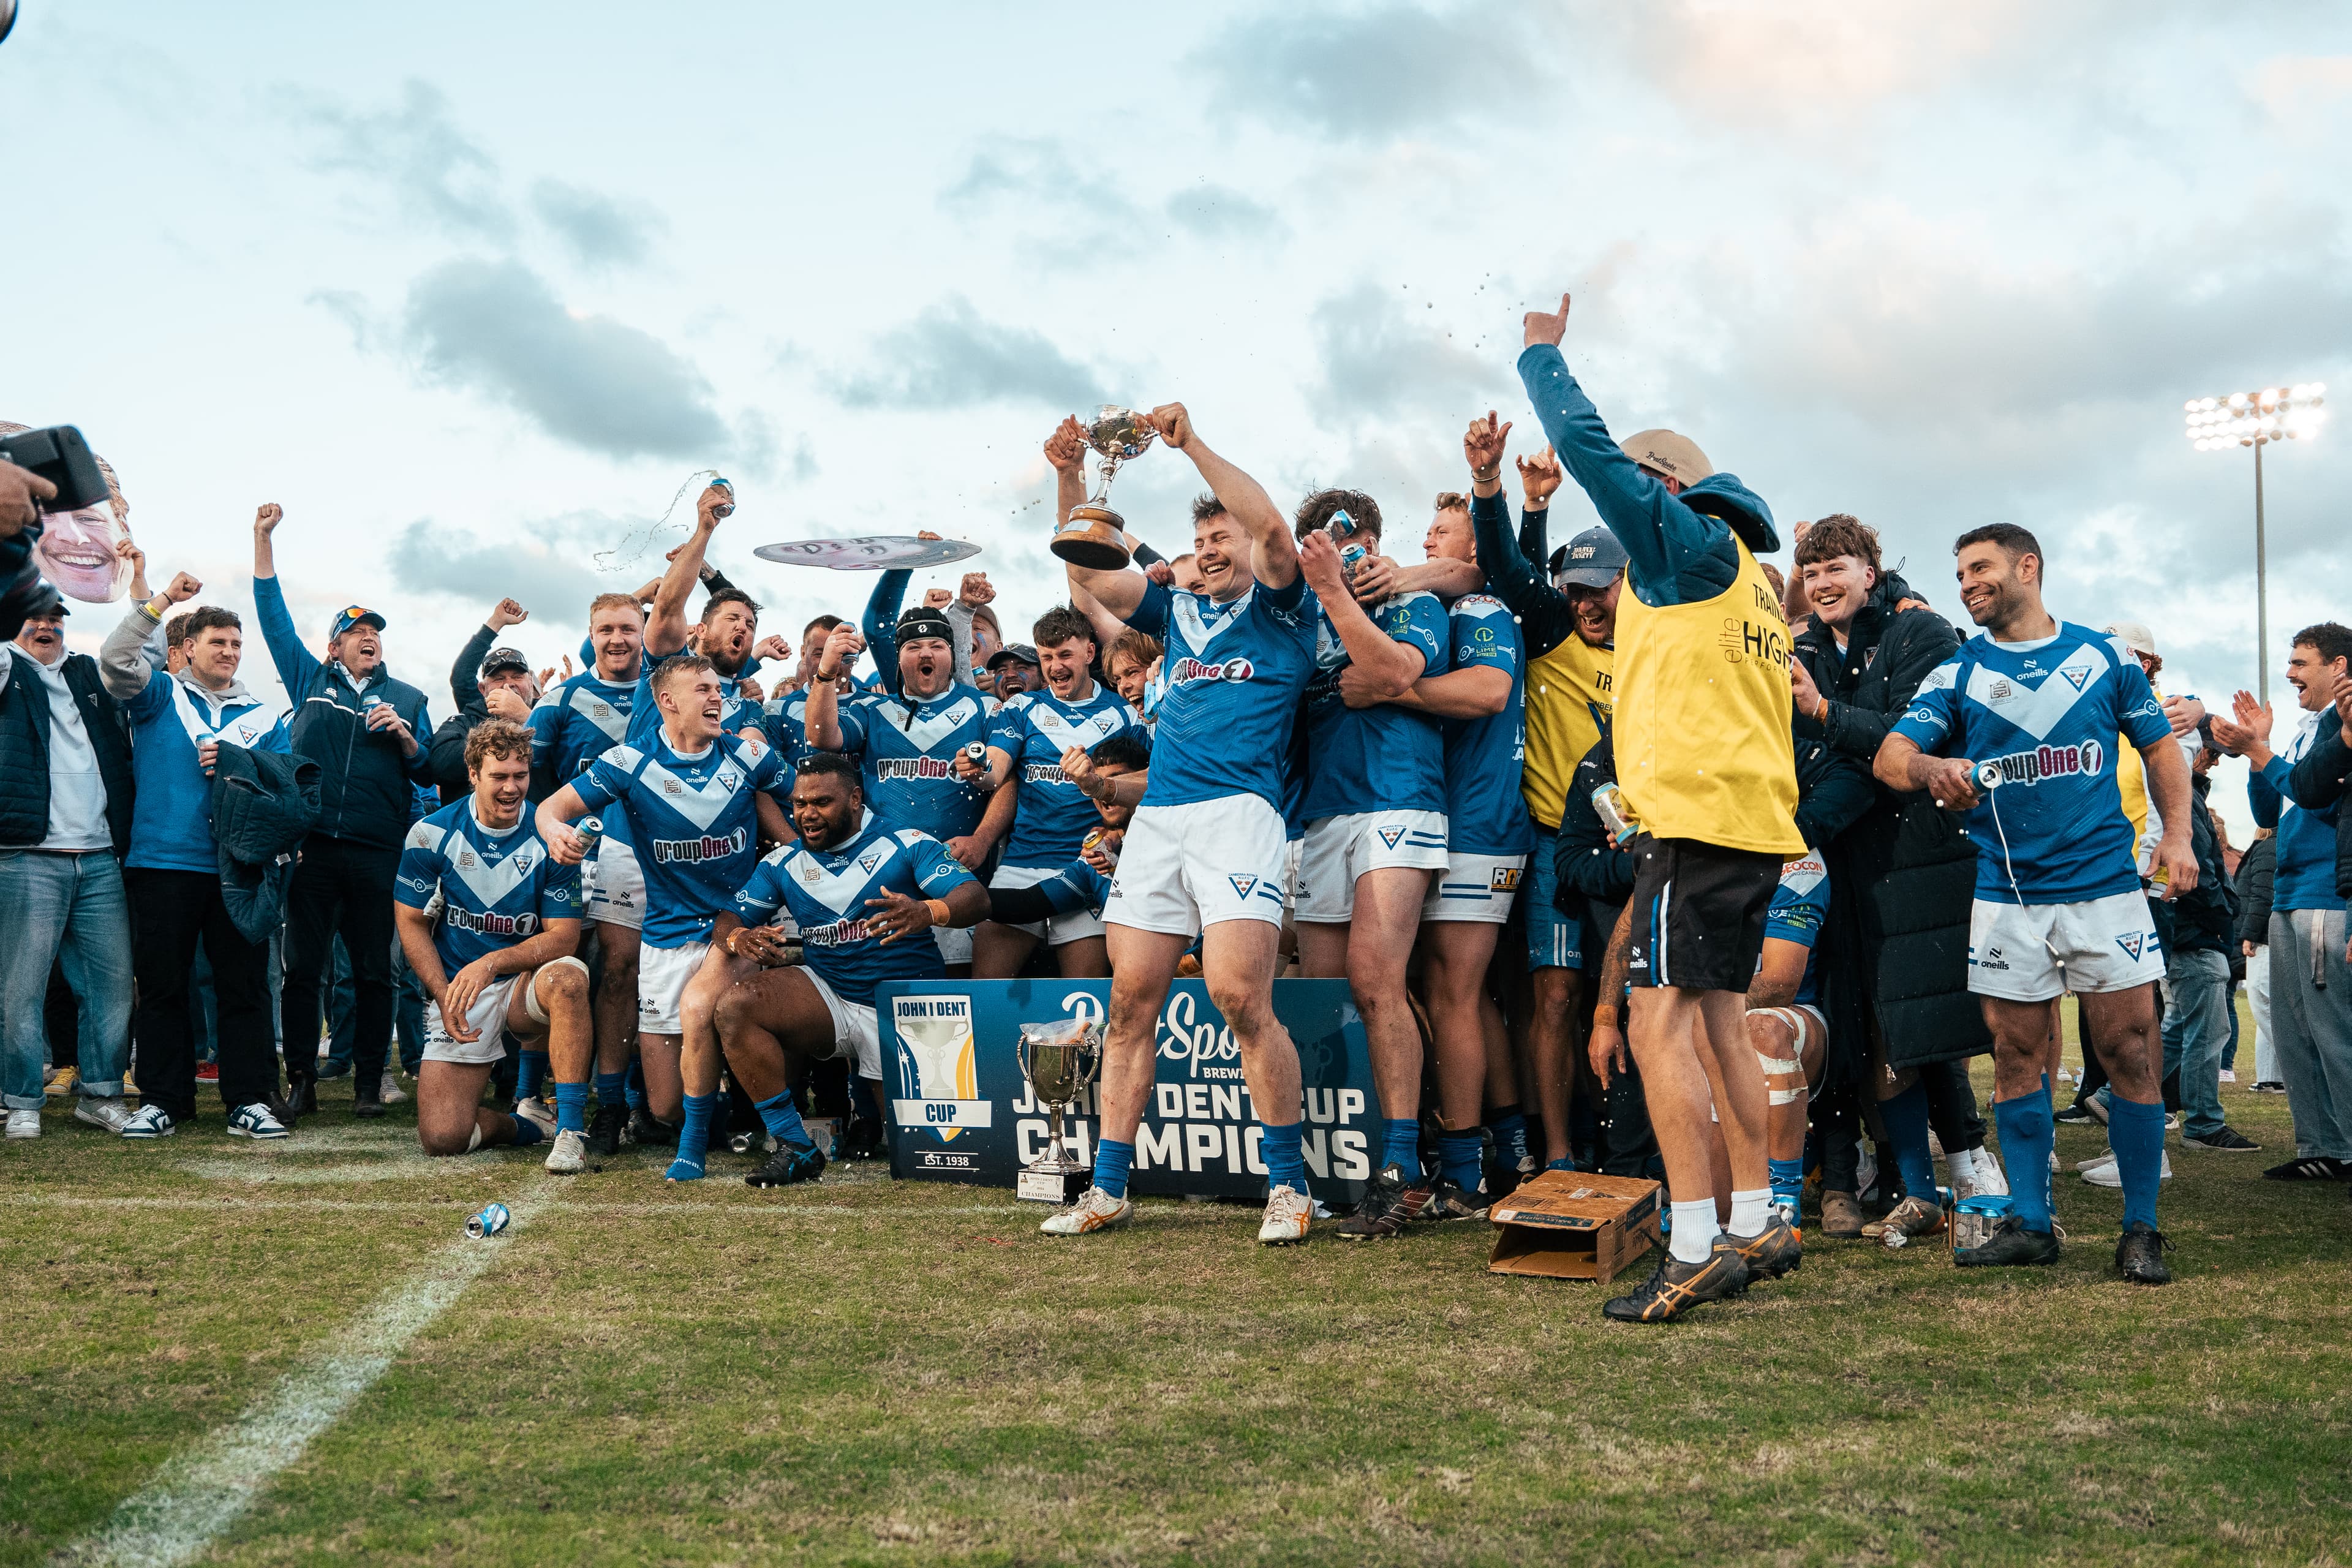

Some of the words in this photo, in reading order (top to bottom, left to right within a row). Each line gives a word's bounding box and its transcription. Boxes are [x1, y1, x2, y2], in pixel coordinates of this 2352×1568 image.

[1719, 618, 1742, 663] elite
[878, 756, 948, 781] groupOne
[1026, 765, 1072, 783] group
[1986, 747, 2079, 783] oupOne
[655, 837, 730, 862] groupOne
[897, 1002, 927, 1016] JOHN
[929, 1002, 934, 1016] I
[937, 1002, 966, 1016] DENT
[925, 1103, 957, 1122] CUP
[1016, 1118, 1370, 1181] CHMPINS
[925, 1156, 943, 1166] EST.
[946, 1156, 969, 1166] 1938
[1022, 1191, 1060, 1199] CHAMPIONS
